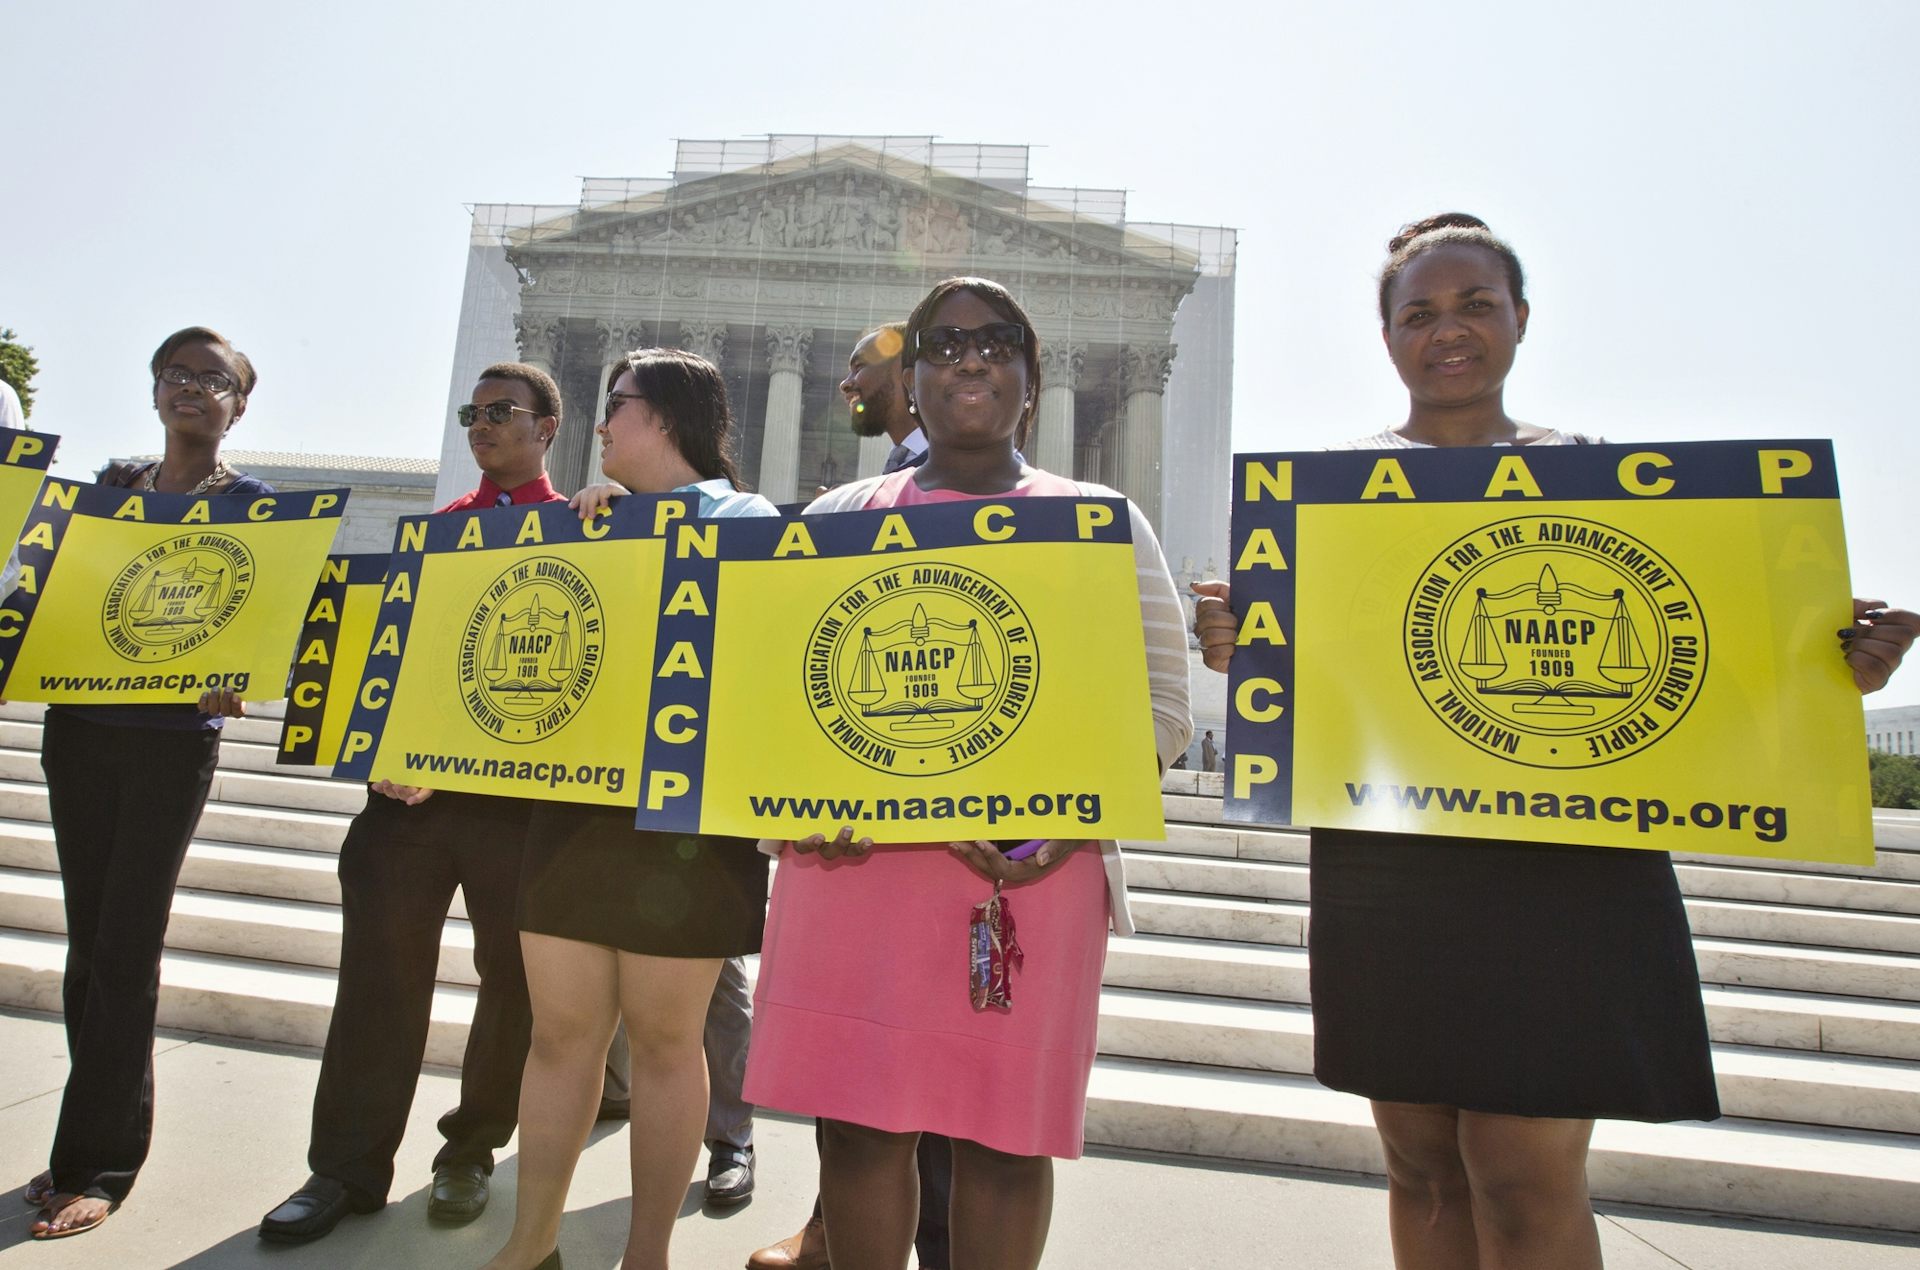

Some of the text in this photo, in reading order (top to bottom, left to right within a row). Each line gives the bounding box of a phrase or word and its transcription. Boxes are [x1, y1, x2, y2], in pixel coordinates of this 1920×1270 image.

[158, 585, 204, 599] NAACP
[163, 607, 184, 615] 1909
[1411, 523, 1697, 758] NATIONAL ASSOCIATION FOR THE ADVANCEMENT OF COLORED PEOPLE
[1505, 619, 1595, 645] NAACP
[463, 562, 599, 735] NATIONAL ASSOCIATION FOR THE ADVANCEMENT OF COLORED PEOPLE
[509, 635, 552, 654] NAACP
[1531, 649, 1570, 658] FOUNDED
[810, 569, 1031, 767] NATIONAL ASSOCIATION FOR THE ADVANCEMENT OF COLORED PEOPLE
[885, 647, 955, 672] NAACP
[1529, 660, 1574, 677] 1909
[40, 671, 250, 693] www.naacp.org
[517, 665, 538, 677] 1909
[905, 674, 936, 682] FOUNDED
[904, 683, 938, 698] 1909
[404, 752, 625, 793] www.naacp.org
[750, 794, 1101, 824] www.naacp.org
[1344, 782, 1788, 843] www.naacp.org
